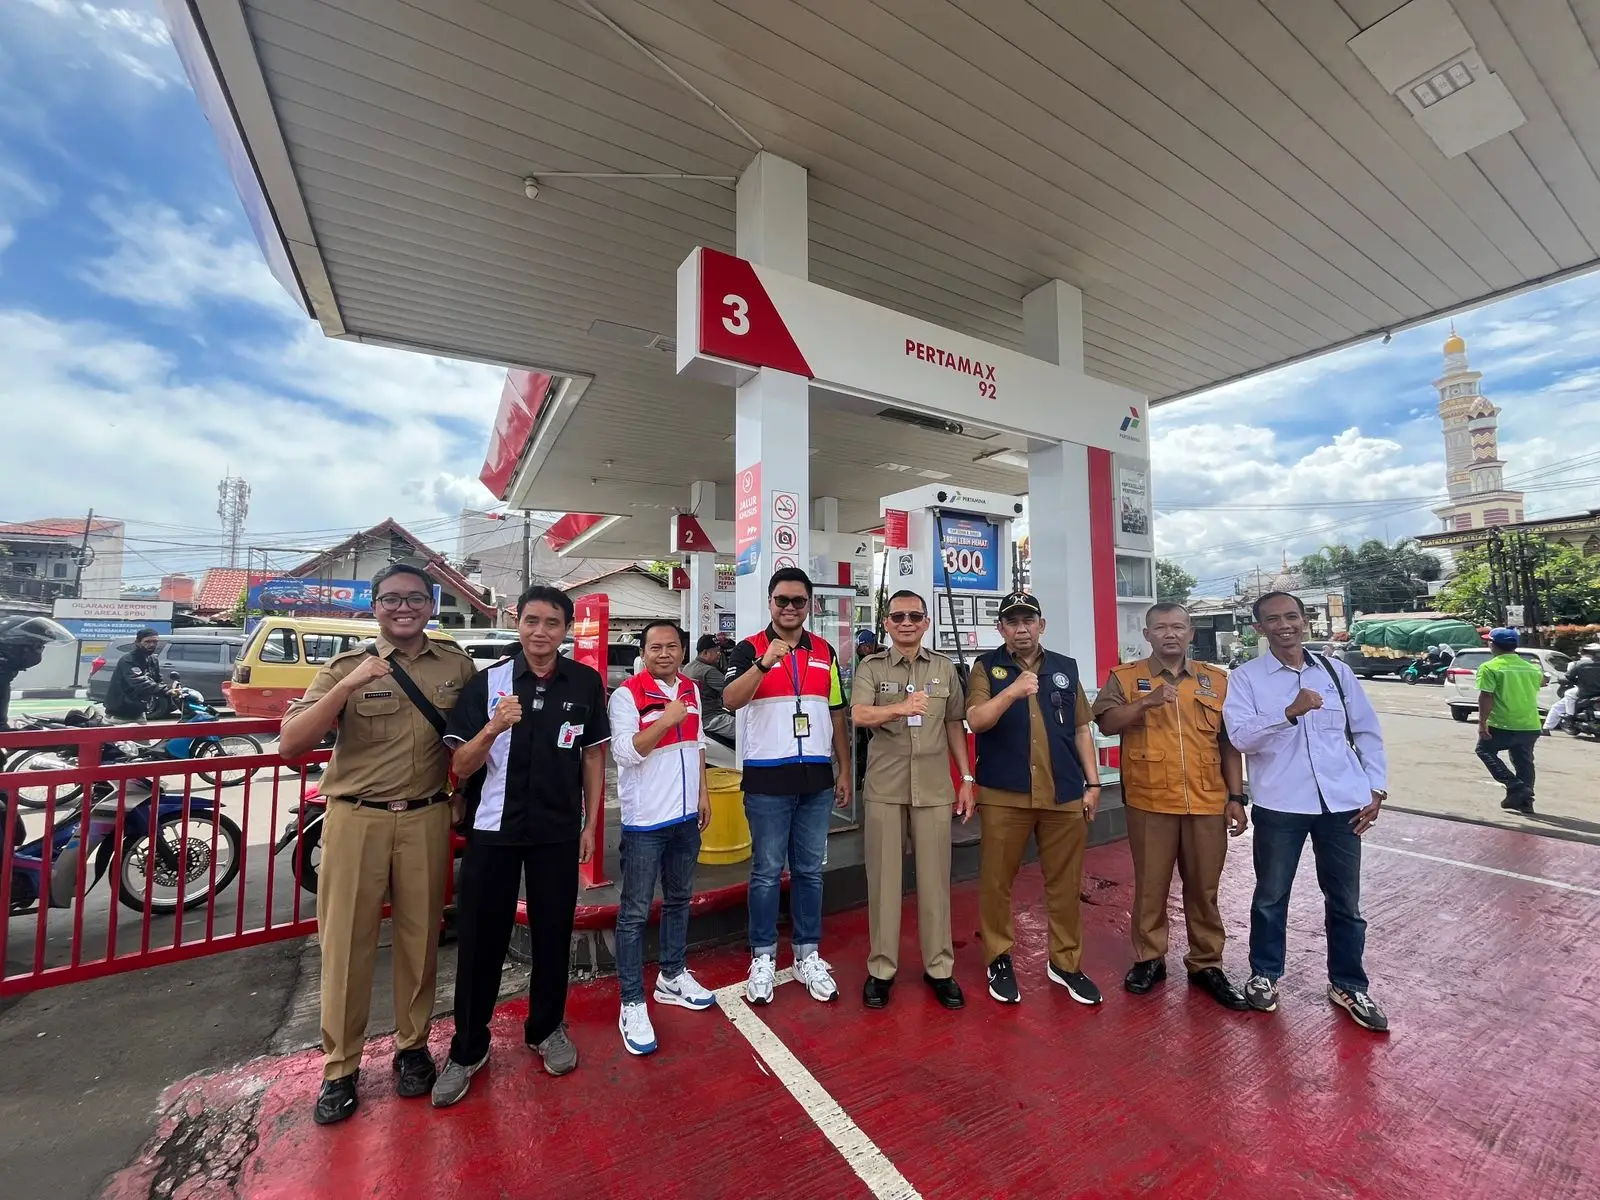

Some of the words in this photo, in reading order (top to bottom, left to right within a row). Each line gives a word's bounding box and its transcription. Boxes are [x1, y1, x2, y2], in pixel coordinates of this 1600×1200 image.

[722, 294, 750, 336] 3
[905, 338, 996, 382] PERTAMAX
[978, 380, 997, 400] 92
[739, 495, 757, 510] JALUR
[962, 496, 986, 504] PERTAMINA
[685, 530, 694, 543] 2
[972, 538, 987, 547] HEMAT
[946, 546, 983, 574] 300
[676, 576, 681, 585] 1
